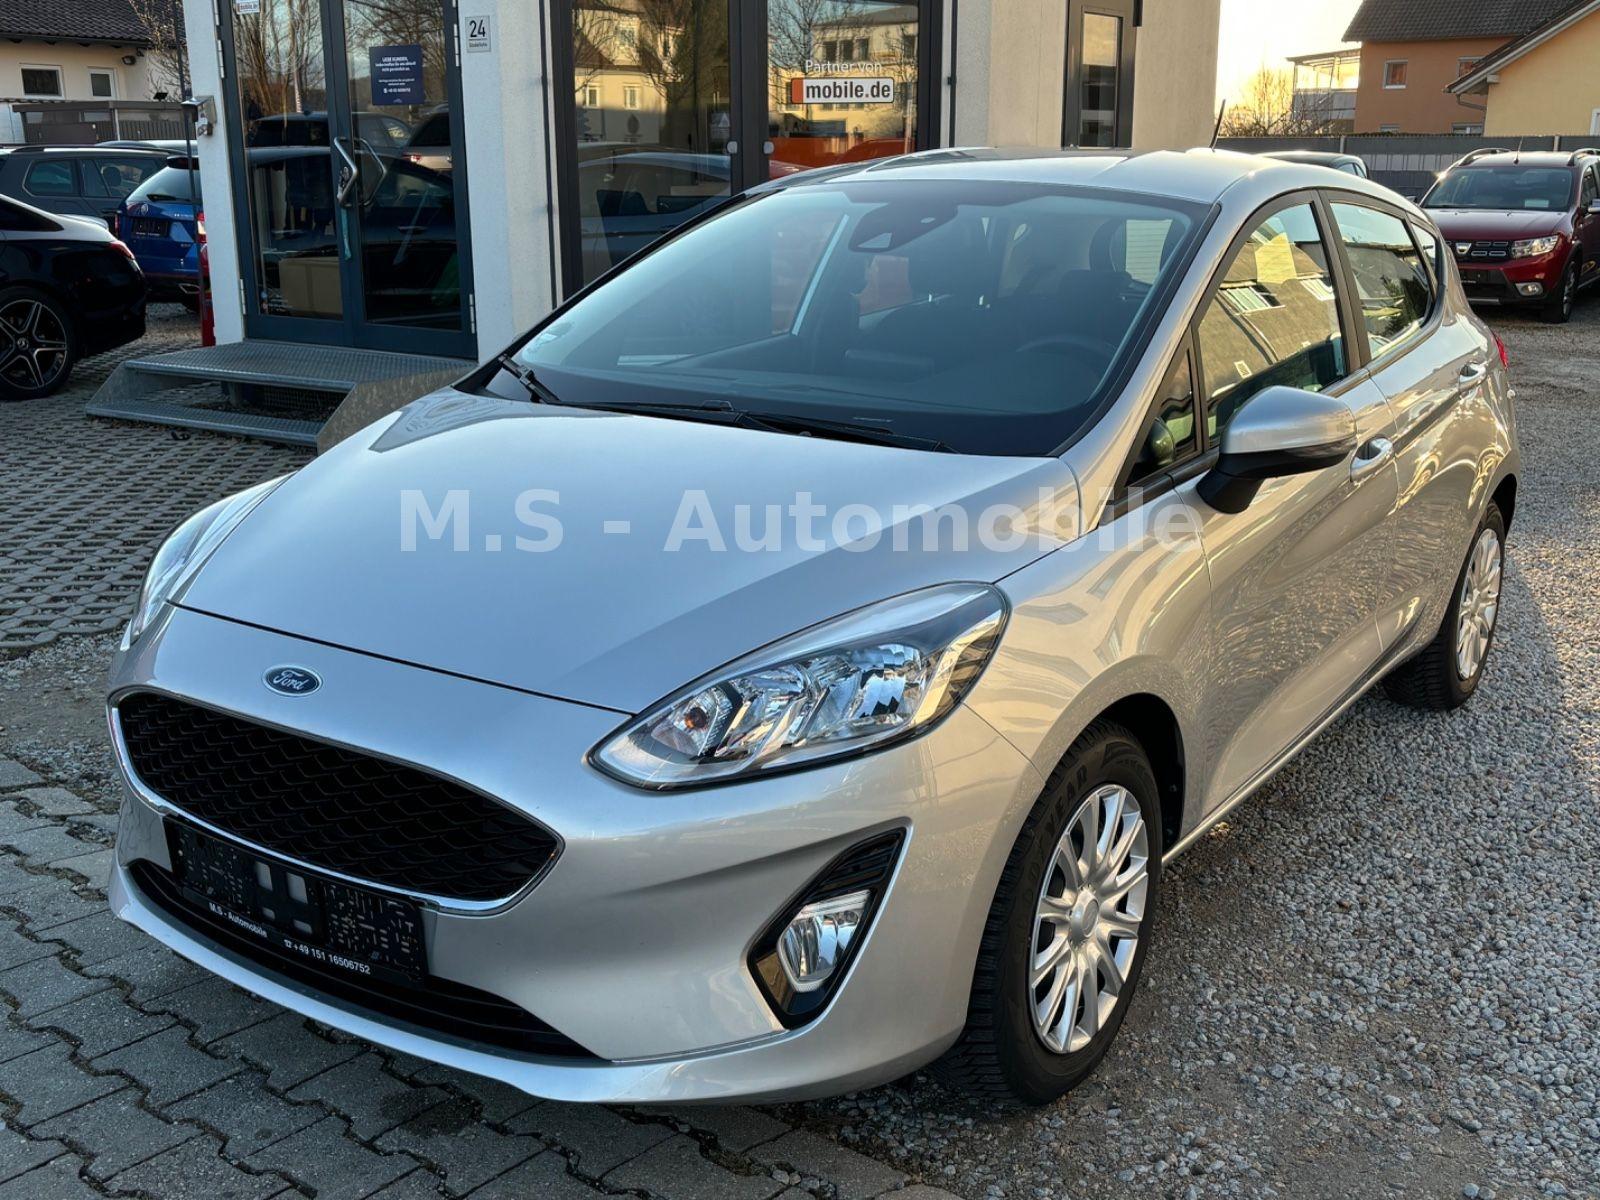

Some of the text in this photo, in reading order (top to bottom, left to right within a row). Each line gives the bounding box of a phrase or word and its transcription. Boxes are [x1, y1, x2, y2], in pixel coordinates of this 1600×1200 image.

[469, 19, 486, 38] 24
[805, 60, 883, 73] Partner von
[806, 81, 891, 99] mobile.de
[273, 670, 309, 691] Ford
[293, 943, 309, 956] +49
[311, 947, 326, 961] 151
[328, 953, 372, 976] 16506752
